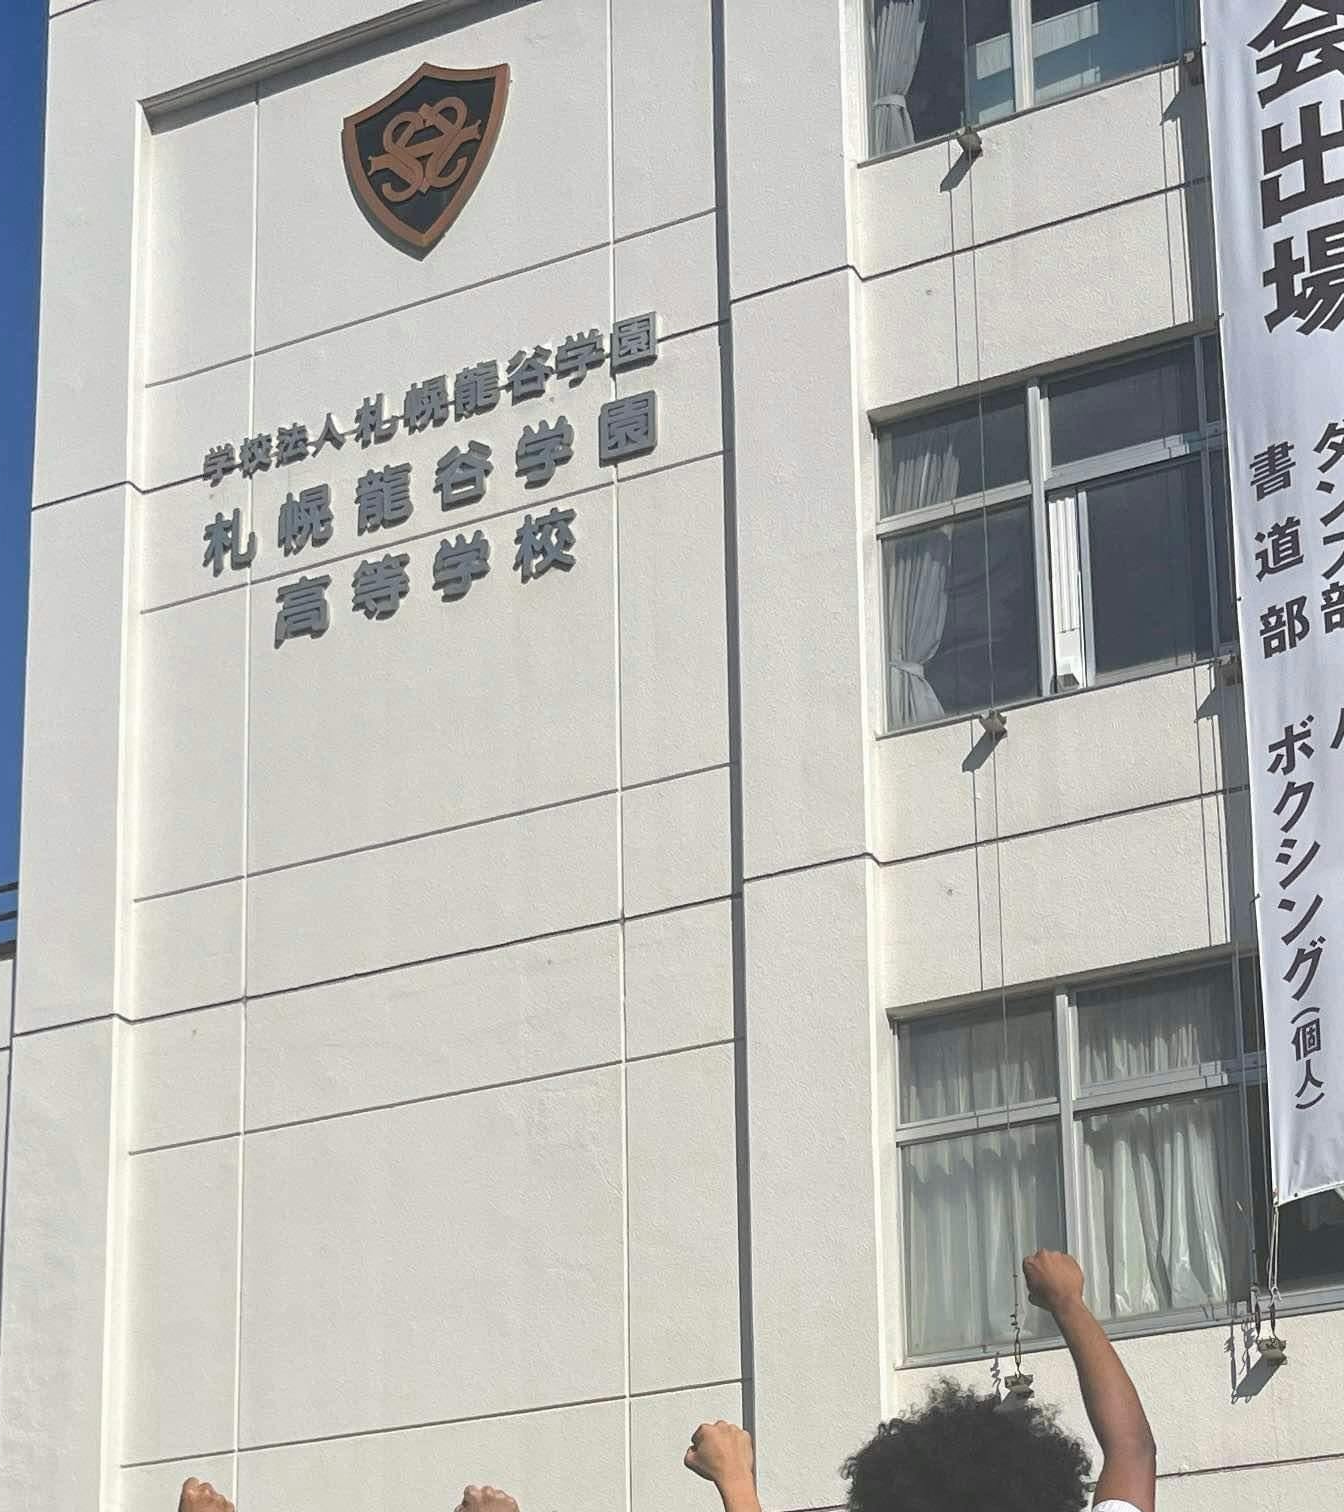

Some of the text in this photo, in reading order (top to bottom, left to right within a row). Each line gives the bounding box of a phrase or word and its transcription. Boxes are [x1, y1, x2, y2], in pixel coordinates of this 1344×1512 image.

[202, 390, 657, 577] 札幌龍谷学園
[203, 311, 658, 487] 学校法人札幌龍谷学園
[274, 507, 578, 649] 高等学校
[1249, 442, 1309, 659] 書道部
